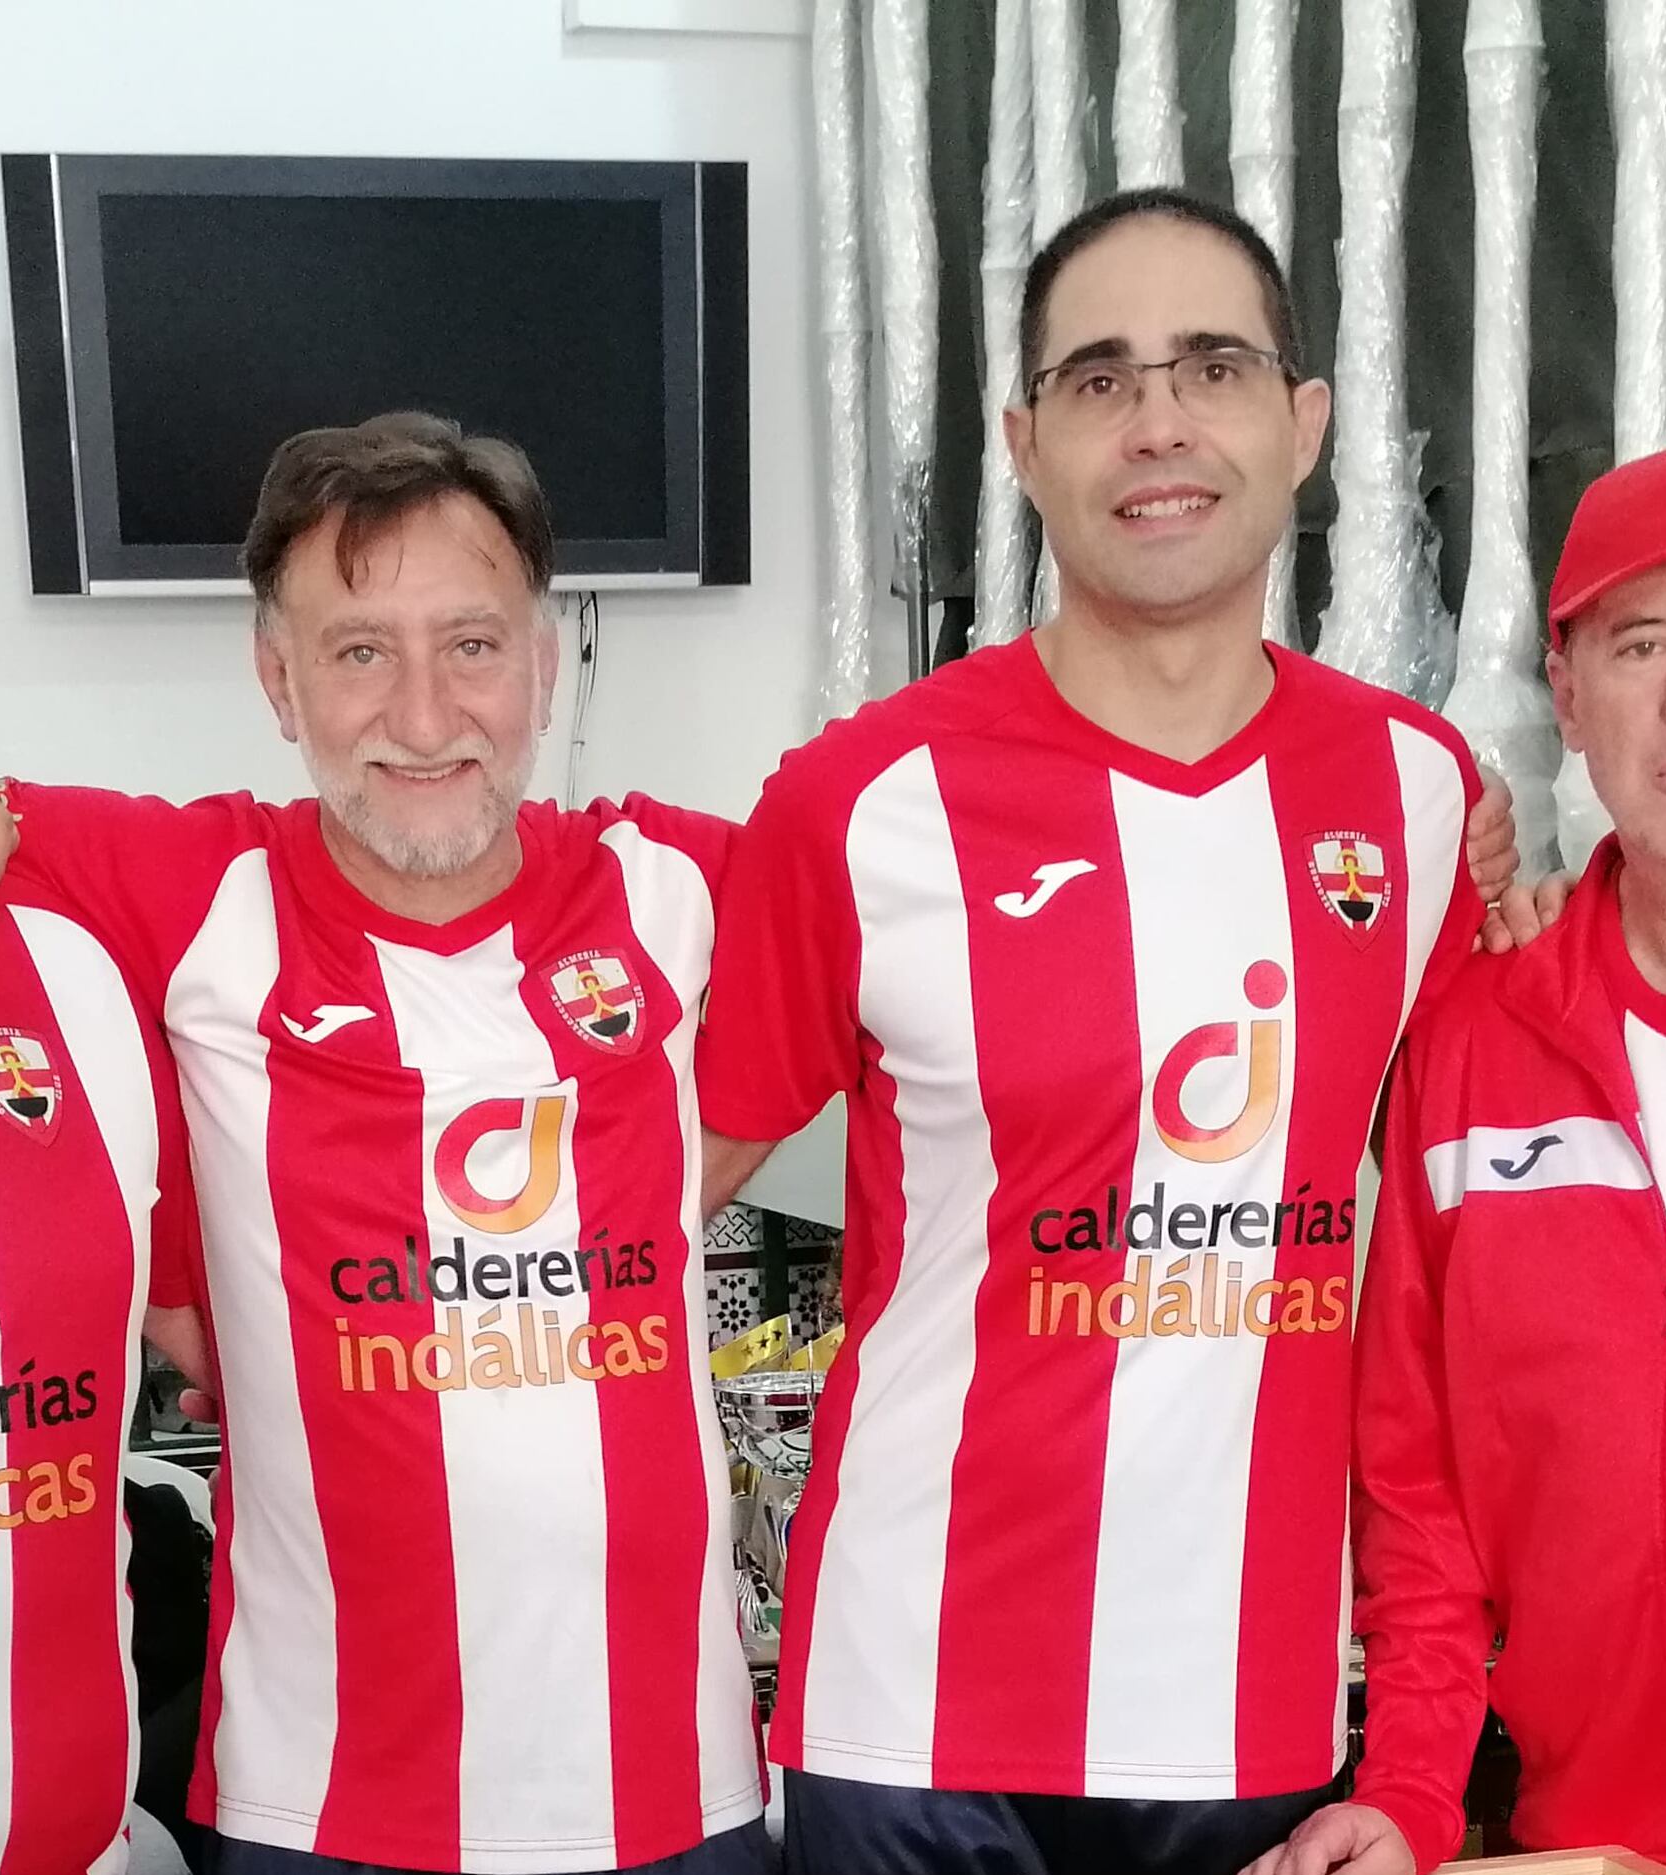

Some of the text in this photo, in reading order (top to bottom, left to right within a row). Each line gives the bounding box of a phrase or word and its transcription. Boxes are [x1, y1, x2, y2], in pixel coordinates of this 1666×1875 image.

[557, 949, 601, 970] ALMERIA
[1030, 1179, 1356, 1253] caldererías
[330, 1228, 658, 1304] caldererías
[1027, 1252, 1347, 1339] indálicas
[334, 1302, 669, 1392] indálicas
